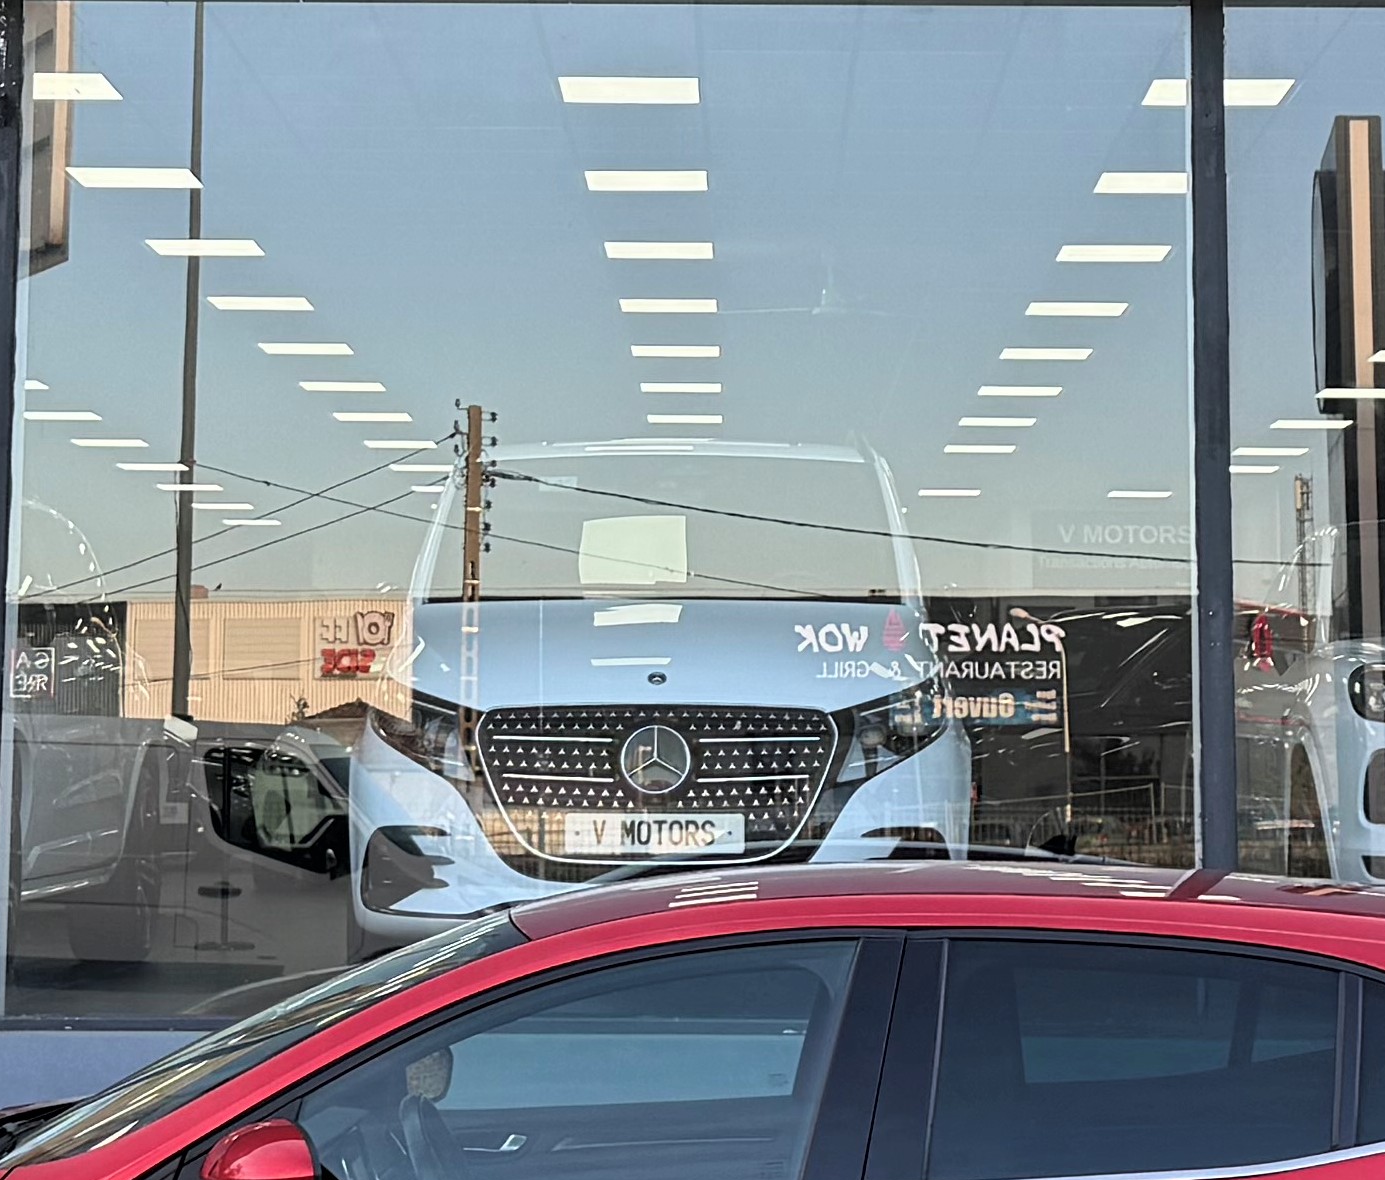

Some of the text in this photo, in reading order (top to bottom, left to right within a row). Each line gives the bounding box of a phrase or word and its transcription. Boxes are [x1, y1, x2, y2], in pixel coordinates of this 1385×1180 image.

[1057, 524, 1191, 545] V MOTORS
[592, 819, 716, 847] V MOTORS
